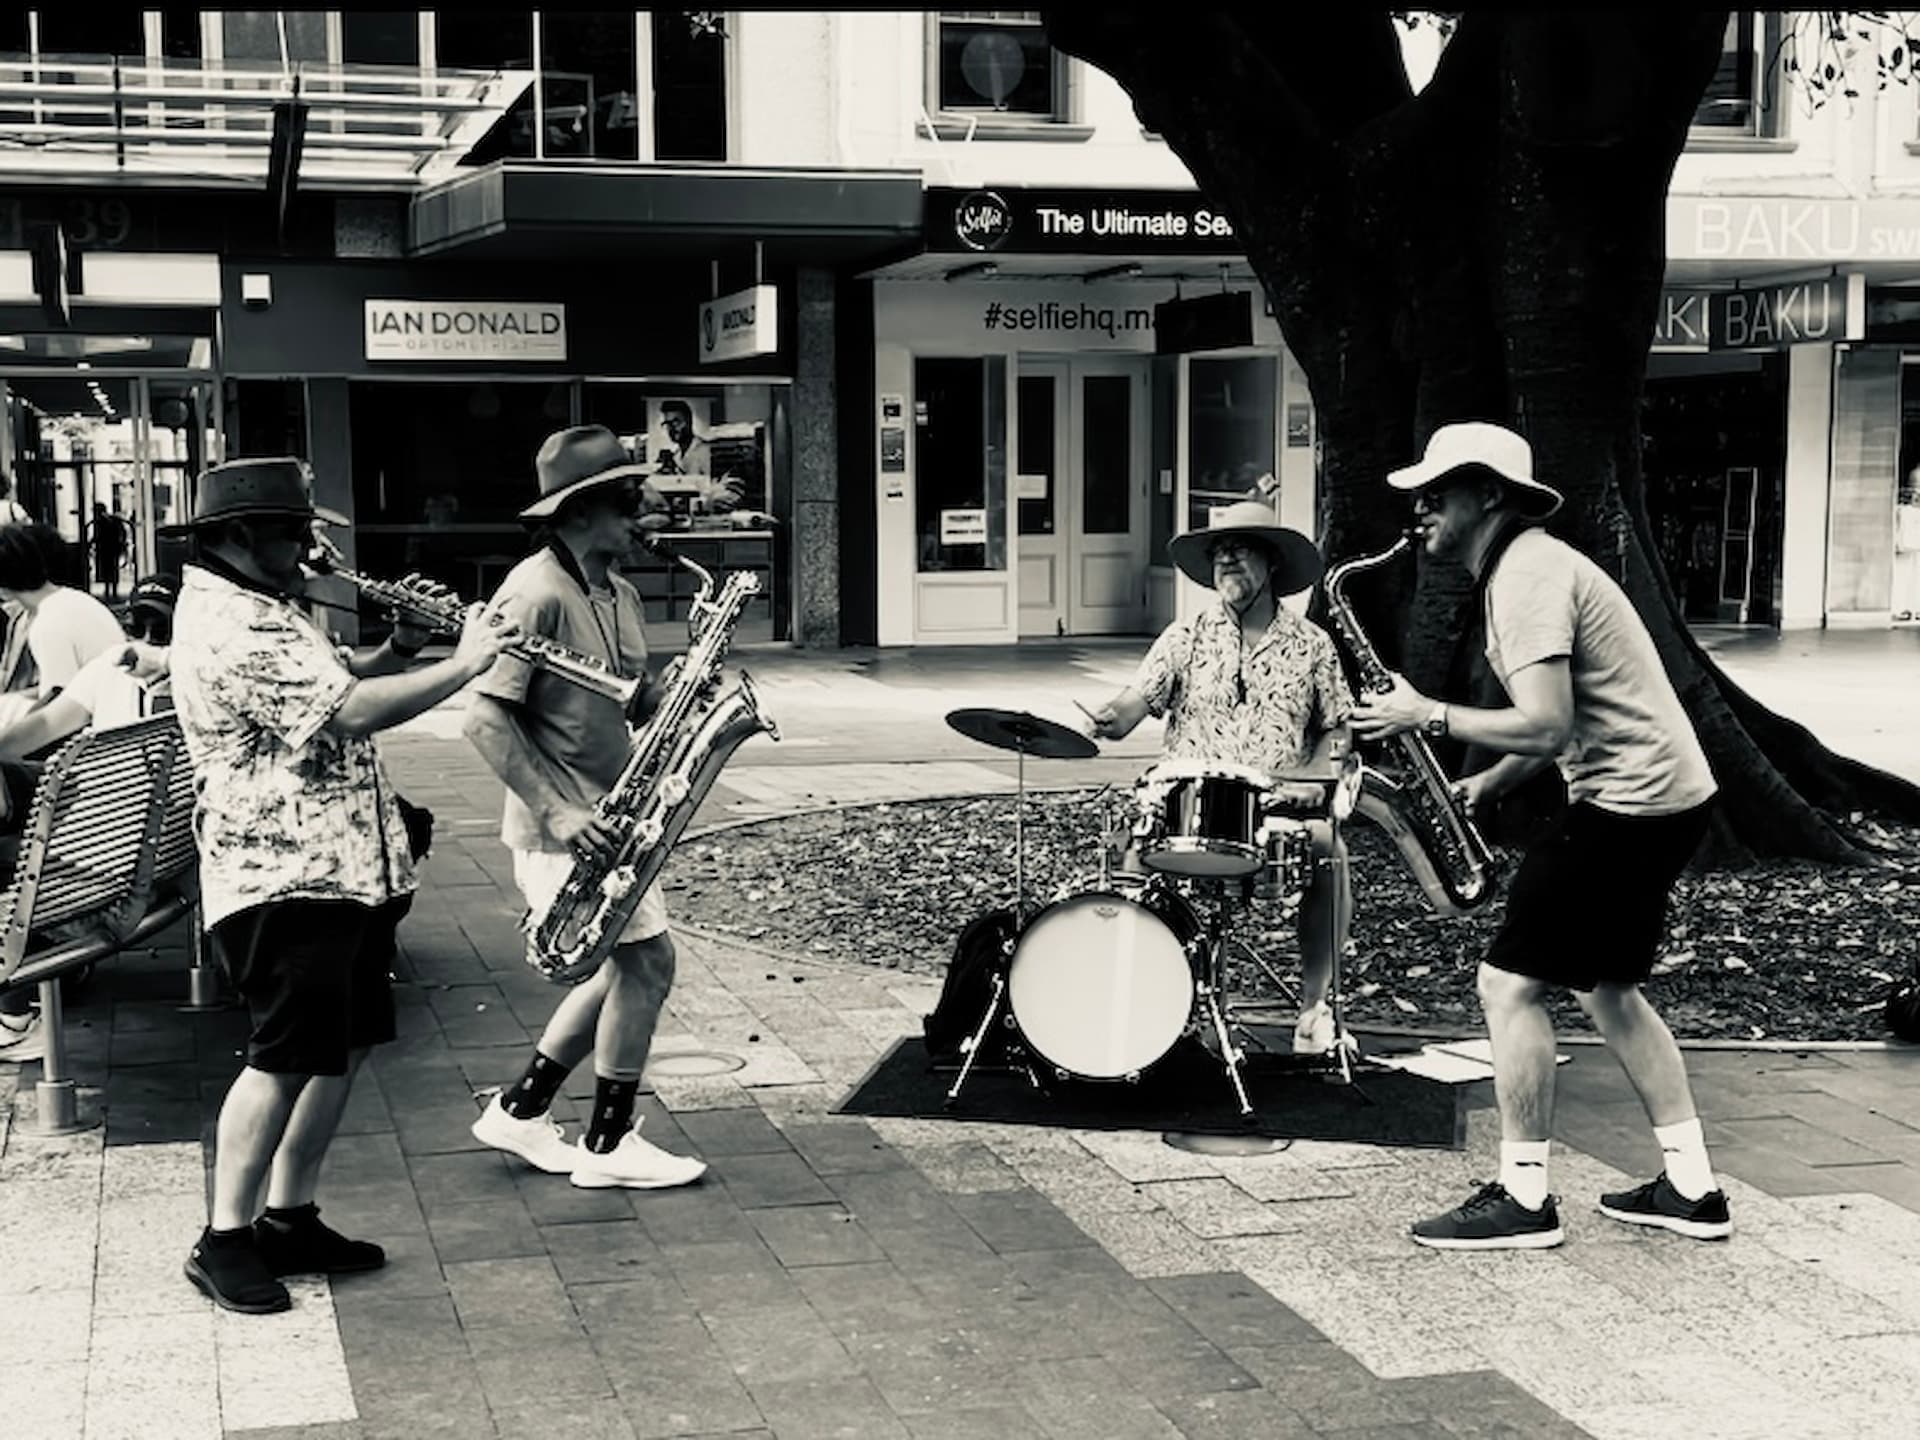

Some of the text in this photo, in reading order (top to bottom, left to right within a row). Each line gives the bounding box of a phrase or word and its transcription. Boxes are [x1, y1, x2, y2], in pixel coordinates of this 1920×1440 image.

[1036, 209, 1085, 234] The
[1092, 209, 1187, 235] Ultimate
[1695, 203, 1860, 256] BAKU
[372, 311, 561, 335] IAN DONALD
[985, 303, 1155, 338] #selfiehq.m
[1725, 283, 1829, 345] BAKU
